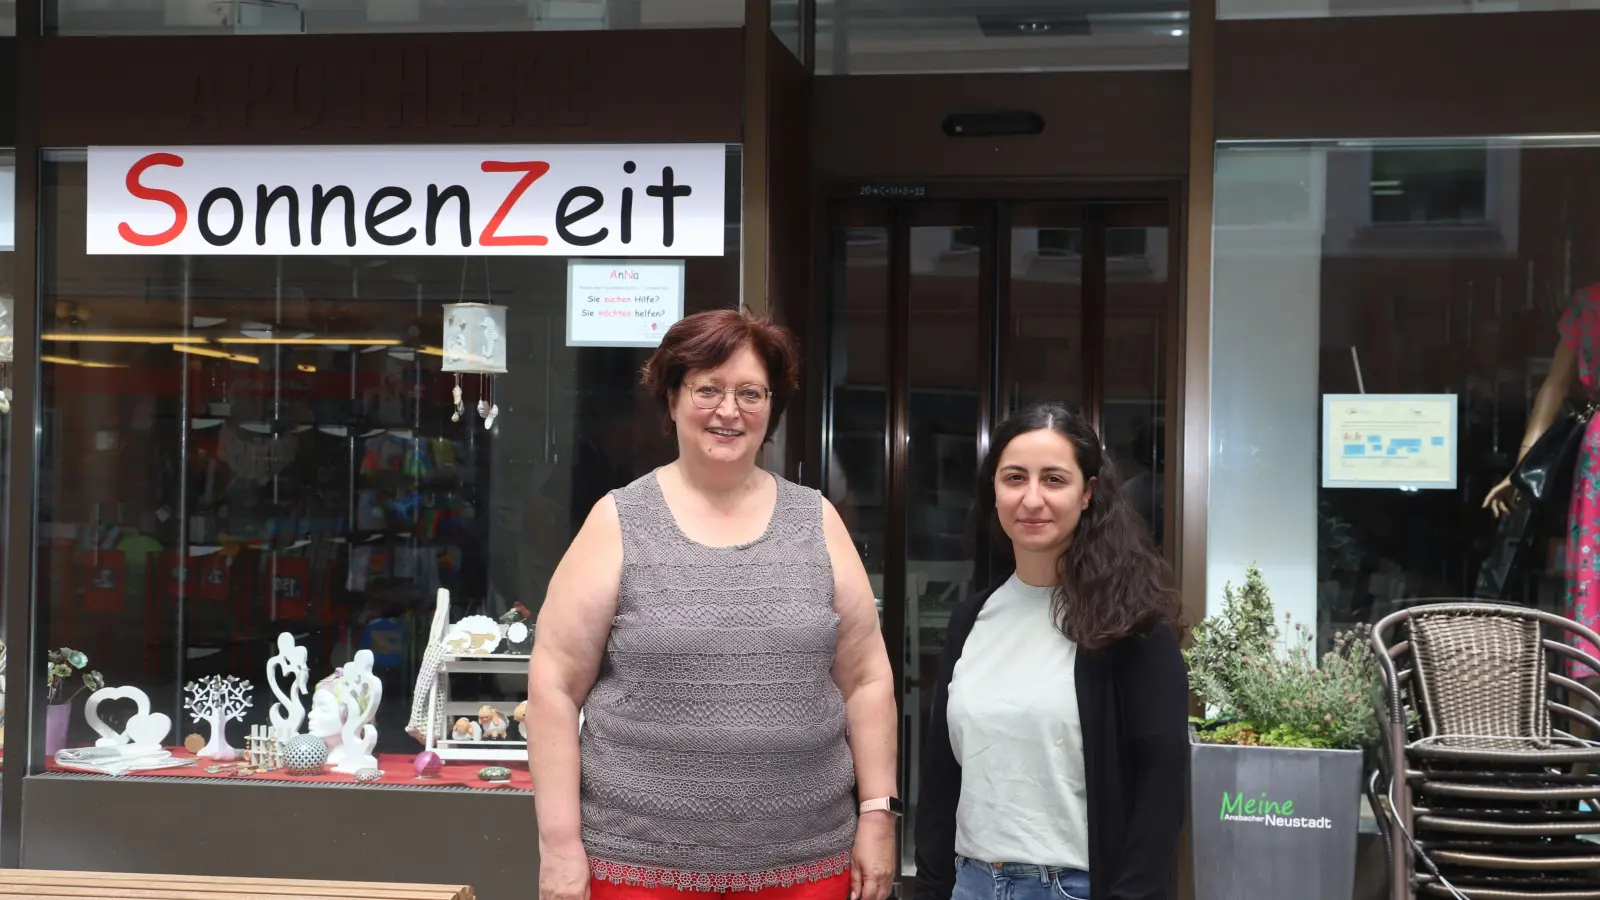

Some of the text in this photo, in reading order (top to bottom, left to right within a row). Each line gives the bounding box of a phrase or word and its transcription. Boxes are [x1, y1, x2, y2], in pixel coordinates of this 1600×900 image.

[187, 45, 591, 130] APOTHEKE
[117, 152, 692, 248] SonnenZeit
[609, 269, 639, 280] AnNa
[587, 295, 660, 303] Sie suchen Hilfe?
[581, 309, 665, 317] Sie möchten helfen?
[1220, 791, 1295, 821] Meine
[1224, 813, 1332, 829] Ansbacher Neustadt
